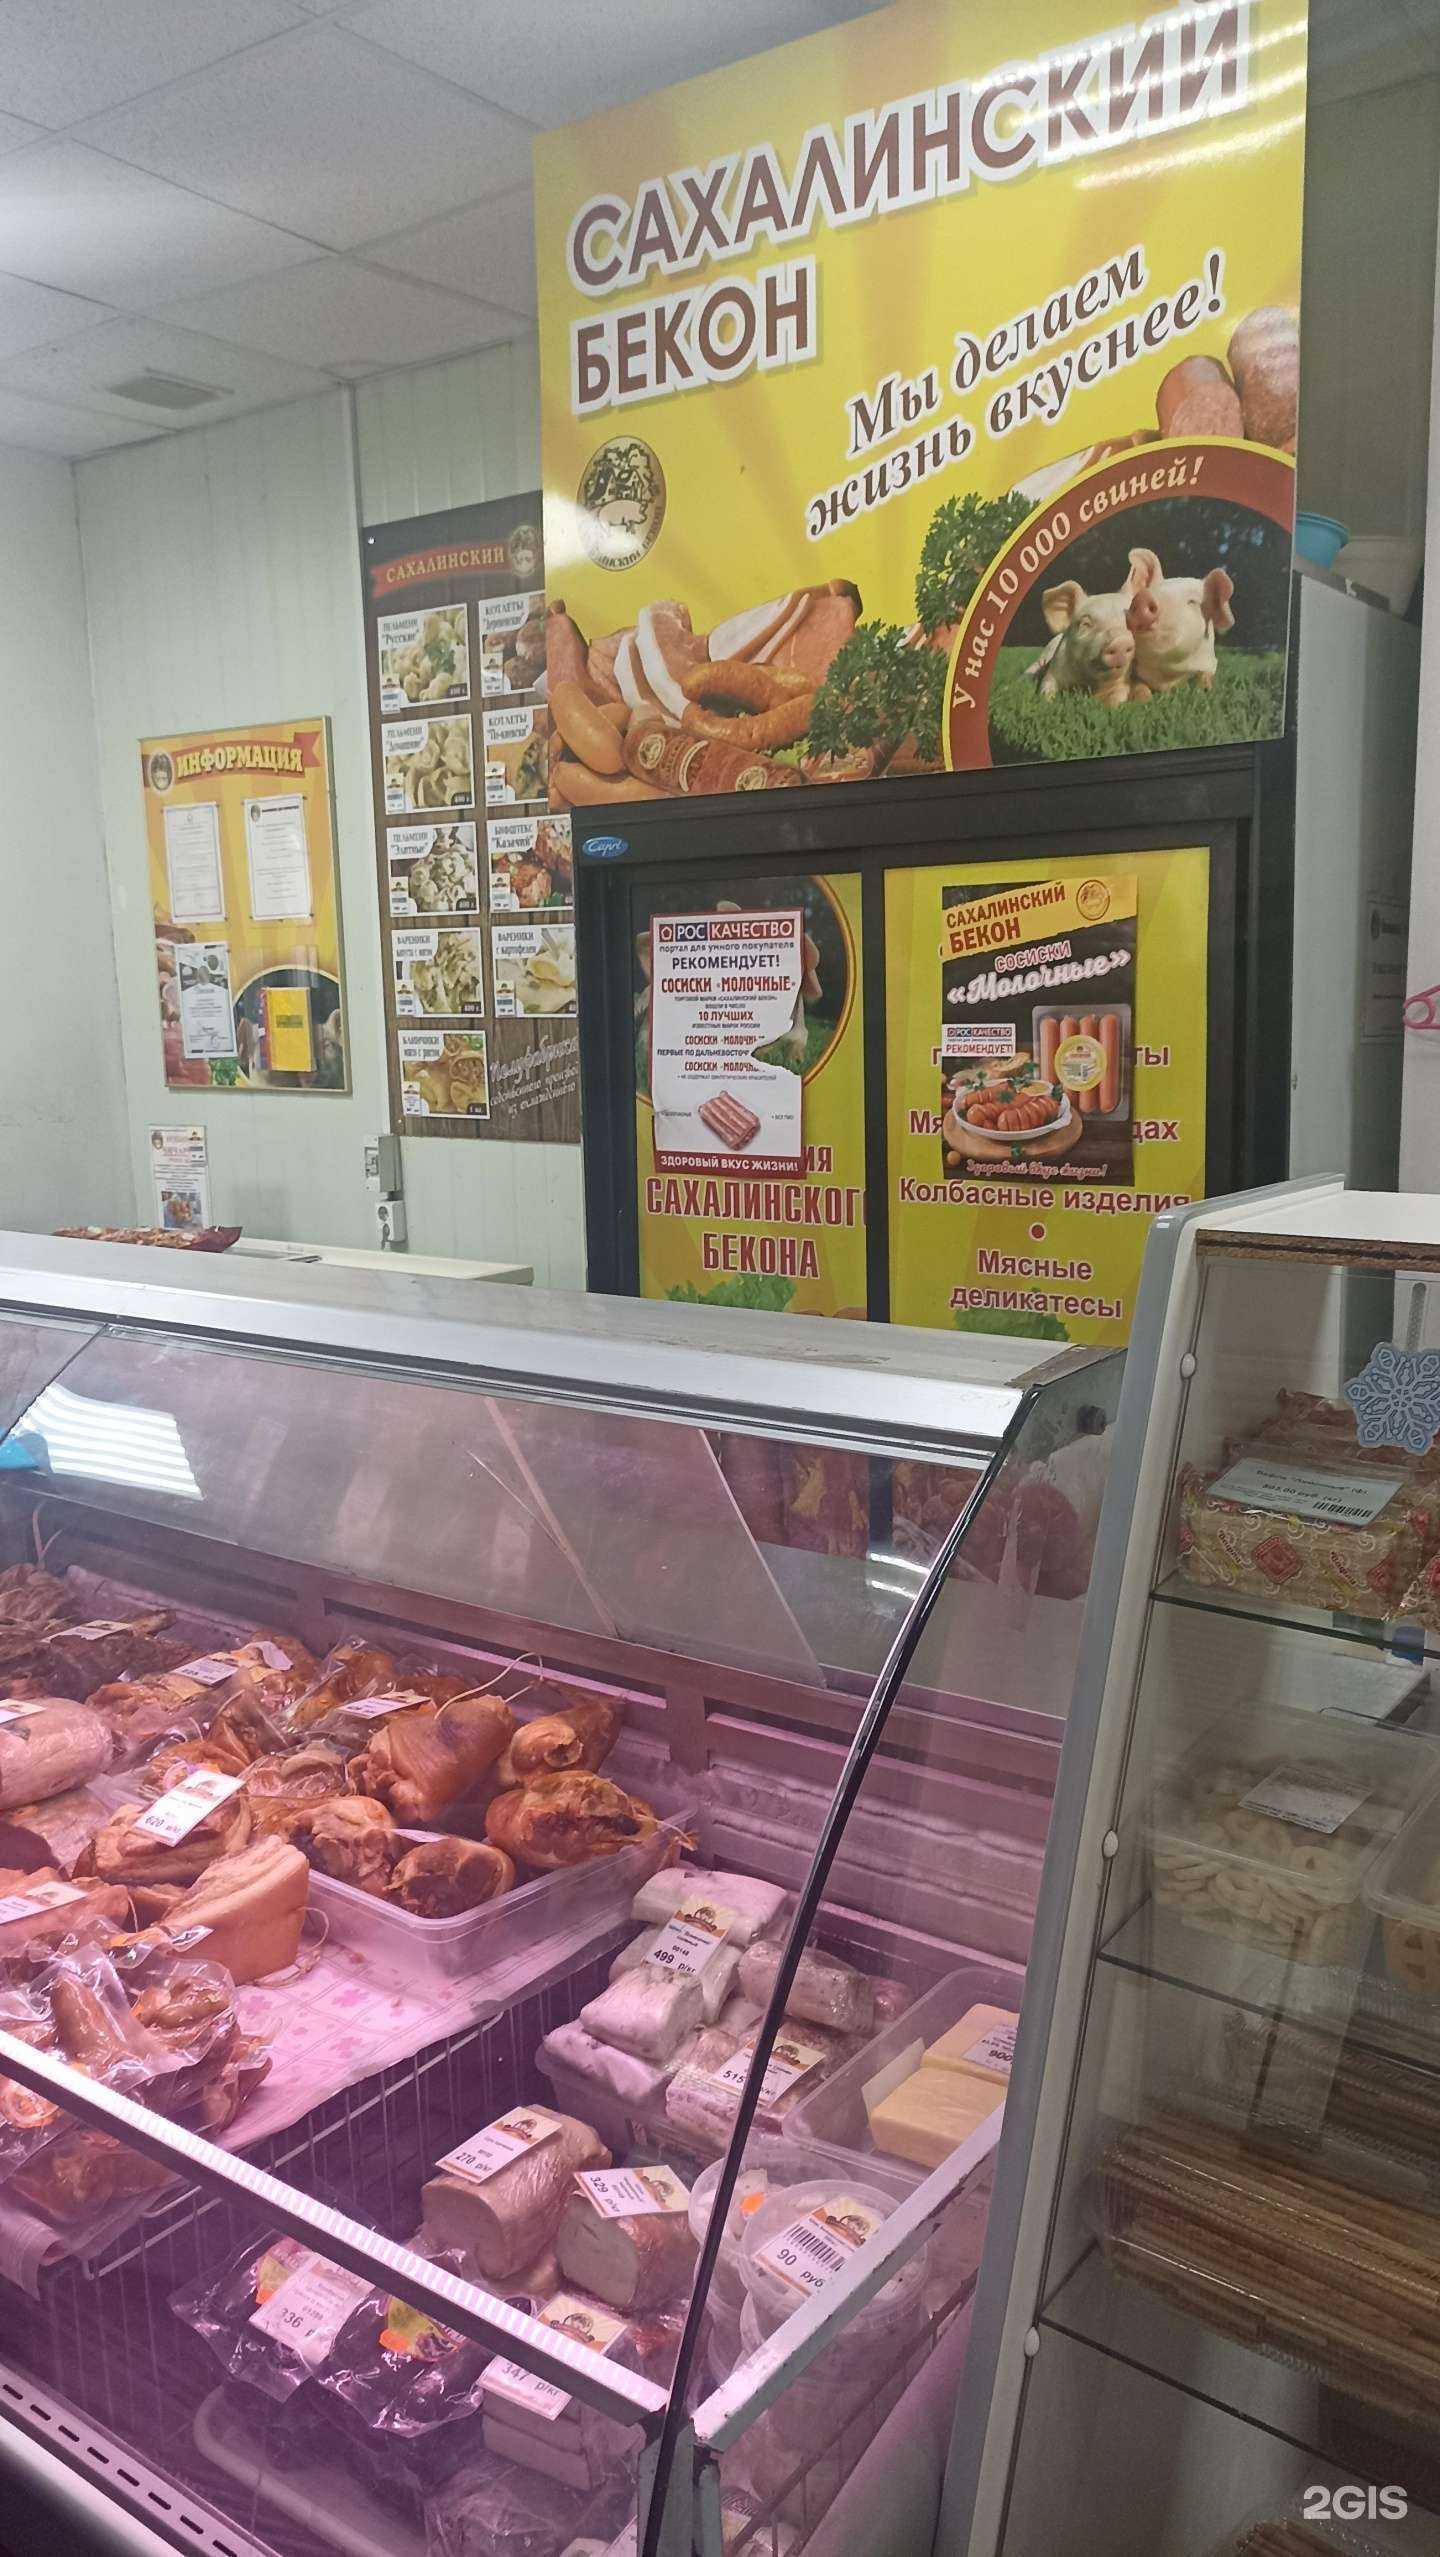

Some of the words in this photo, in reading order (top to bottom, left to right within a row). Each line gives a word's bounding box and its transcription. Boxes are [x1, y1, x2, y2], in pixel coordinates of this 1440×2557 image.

[572, 0, 1239, 287] САХАЛИНСКИЙ
[575, 267, 810, 405] БЕКОН
[849, 374, 936, 454] Мы
[953, 250, 1145, 390] делаем
[808, 420, 972, 540] жизнь
[989, 252, 1225, 434] вкуснее!
[964, 618, 995, 679] нас
[986, 568, 1019, 616] 10
[1019, 511, 1072, 574] 000
[1078, 455, 1205, 523] свиней!
[175, 745, 304, 776] ИНФОРМАЦИЯ
[946, 881, 1067, 928] САХАЛИНСКИЙ
[676, 924, 707, 940] РОС
[710, 920, 794, 939] КАЧЕСТВО
[949, 917, 1022, 954] БЕКОН
[659, 945, 689, 953] портал
[690, 944, 706, 952] для
[709, 943, 740, 952] умного
[742, 941, 795, 951] покупателя
[994, 940, 1072, 973] СОСИСКИ
[671, 954, 780, 971] РЕКОМЕНДУЕТ!
[661, 976, 713, 994] СОСИСКИ
[698, 1011, 709, 1021] 10
[710, 1011, 754, 1021] ЛУЧШИХ
[657, 1048, 683, 1056] ПЕРВЫЕ
[685, 1035, 718, 1046] СОСИСКИ
[946, 1044, 1013, 1055] РЕКОМЕНДУЕТ!
[684, 1062, 718, 1071] СОСИСКИ
[660, 1155, 719, 1168] ЗДОРОВЫЙ
[720, 1159, 750, 1170] ВКУС
[751, 1160, 799, 1172] ЖИЗНИ!
[646, 1178, 867, 1227] САХАЛИНСКОГ
[899, 1177, 1055, 1208] Колбасные
[703, 1233, 820, 1278] БЕКОНА
[978, 1249, 1093, 1280] Мясные
[950, 1287, 1122, 1319] деликатесы
[653, 1949, 675, 1964] 499
[988, 2049, 1013, 2062] 900
[722, 2070, 744, 2084] 515
[456, 2152, 476, 2165] 270
[590, 2176, 609, 2194] 329
[776, 2248, 798, 2266] 90
[799, 2270, 826, 2288] руб
[281, 2307, 304, 2328] 336
[502, 2362, 530, 2381] 347
[533, 2381, 561, 2397] р/кг
